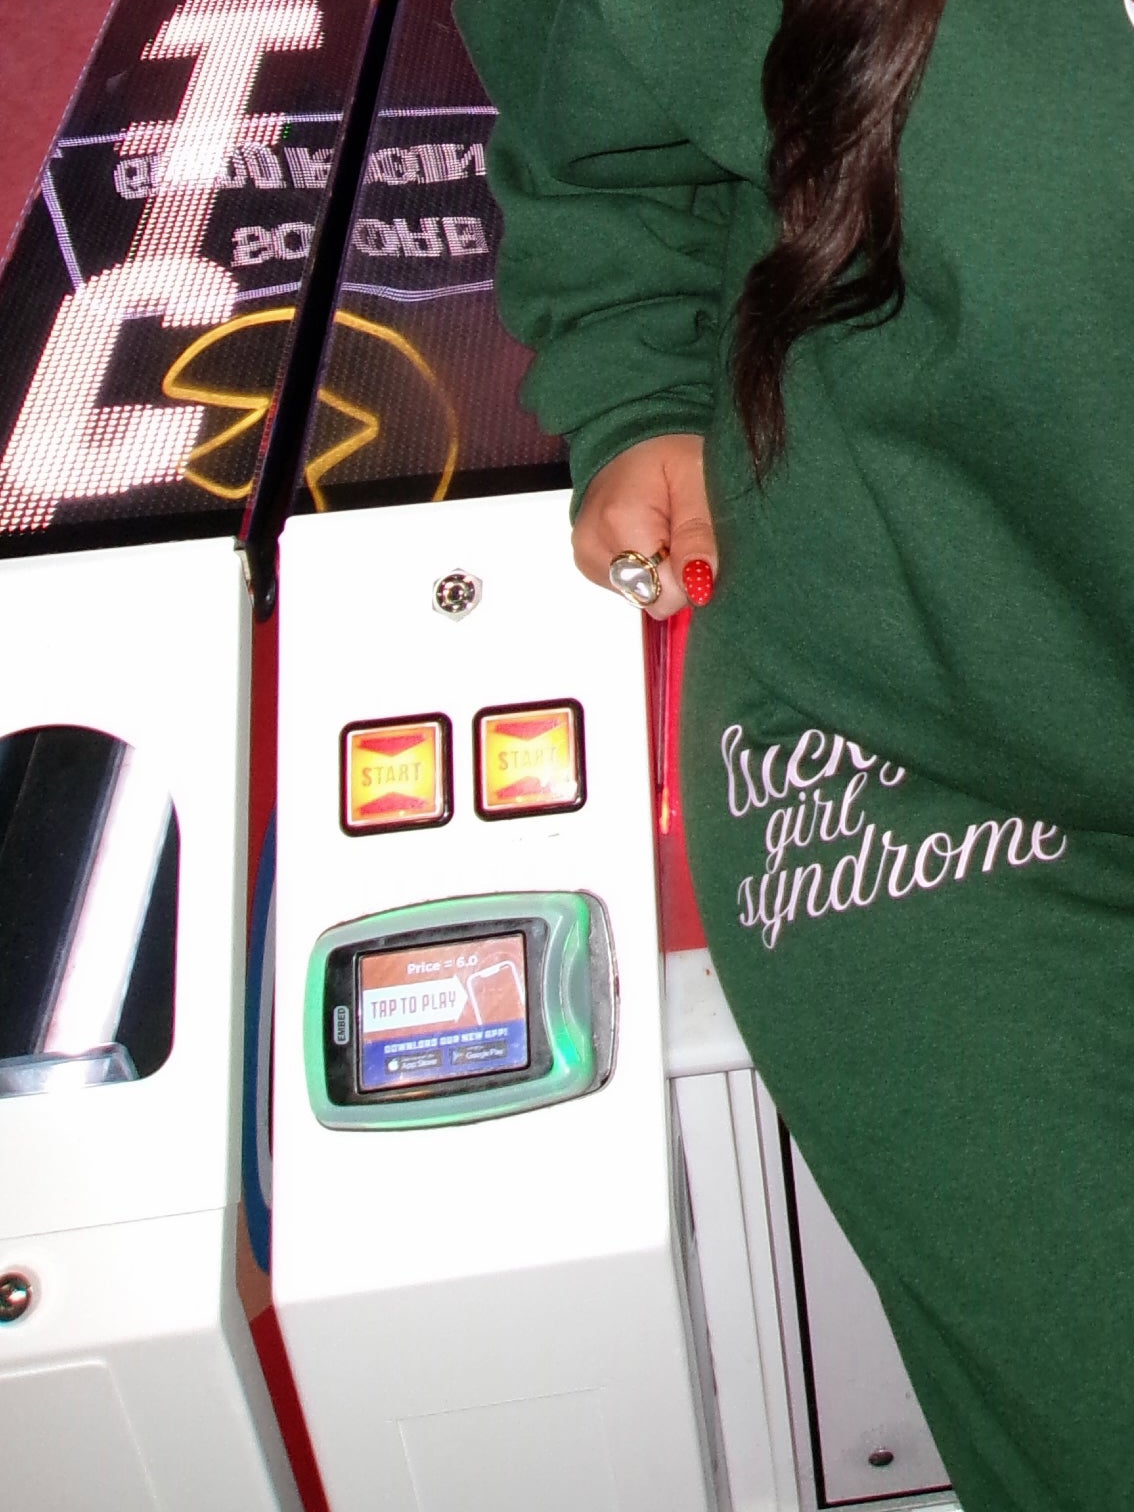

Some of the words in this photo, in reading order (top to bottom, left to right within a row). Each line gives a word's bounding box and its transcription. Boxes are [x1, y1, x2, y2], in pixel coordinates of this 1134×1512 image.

[498, 746, 558, 771] START
[362, 761, 423, 787] START
[766, 771, 868, 874] girl
[737, 817, 1068, 950] syndrome
[407, 960, 441, 974] Price
[457, 955, 478, 968] 6.0
[371, 999, 397, 1019] TAP
[401, 997, 417, 1015] TO
[422, 991, 457, 1011] PLAY
[337, 1008, 346, 1042] EMBED
